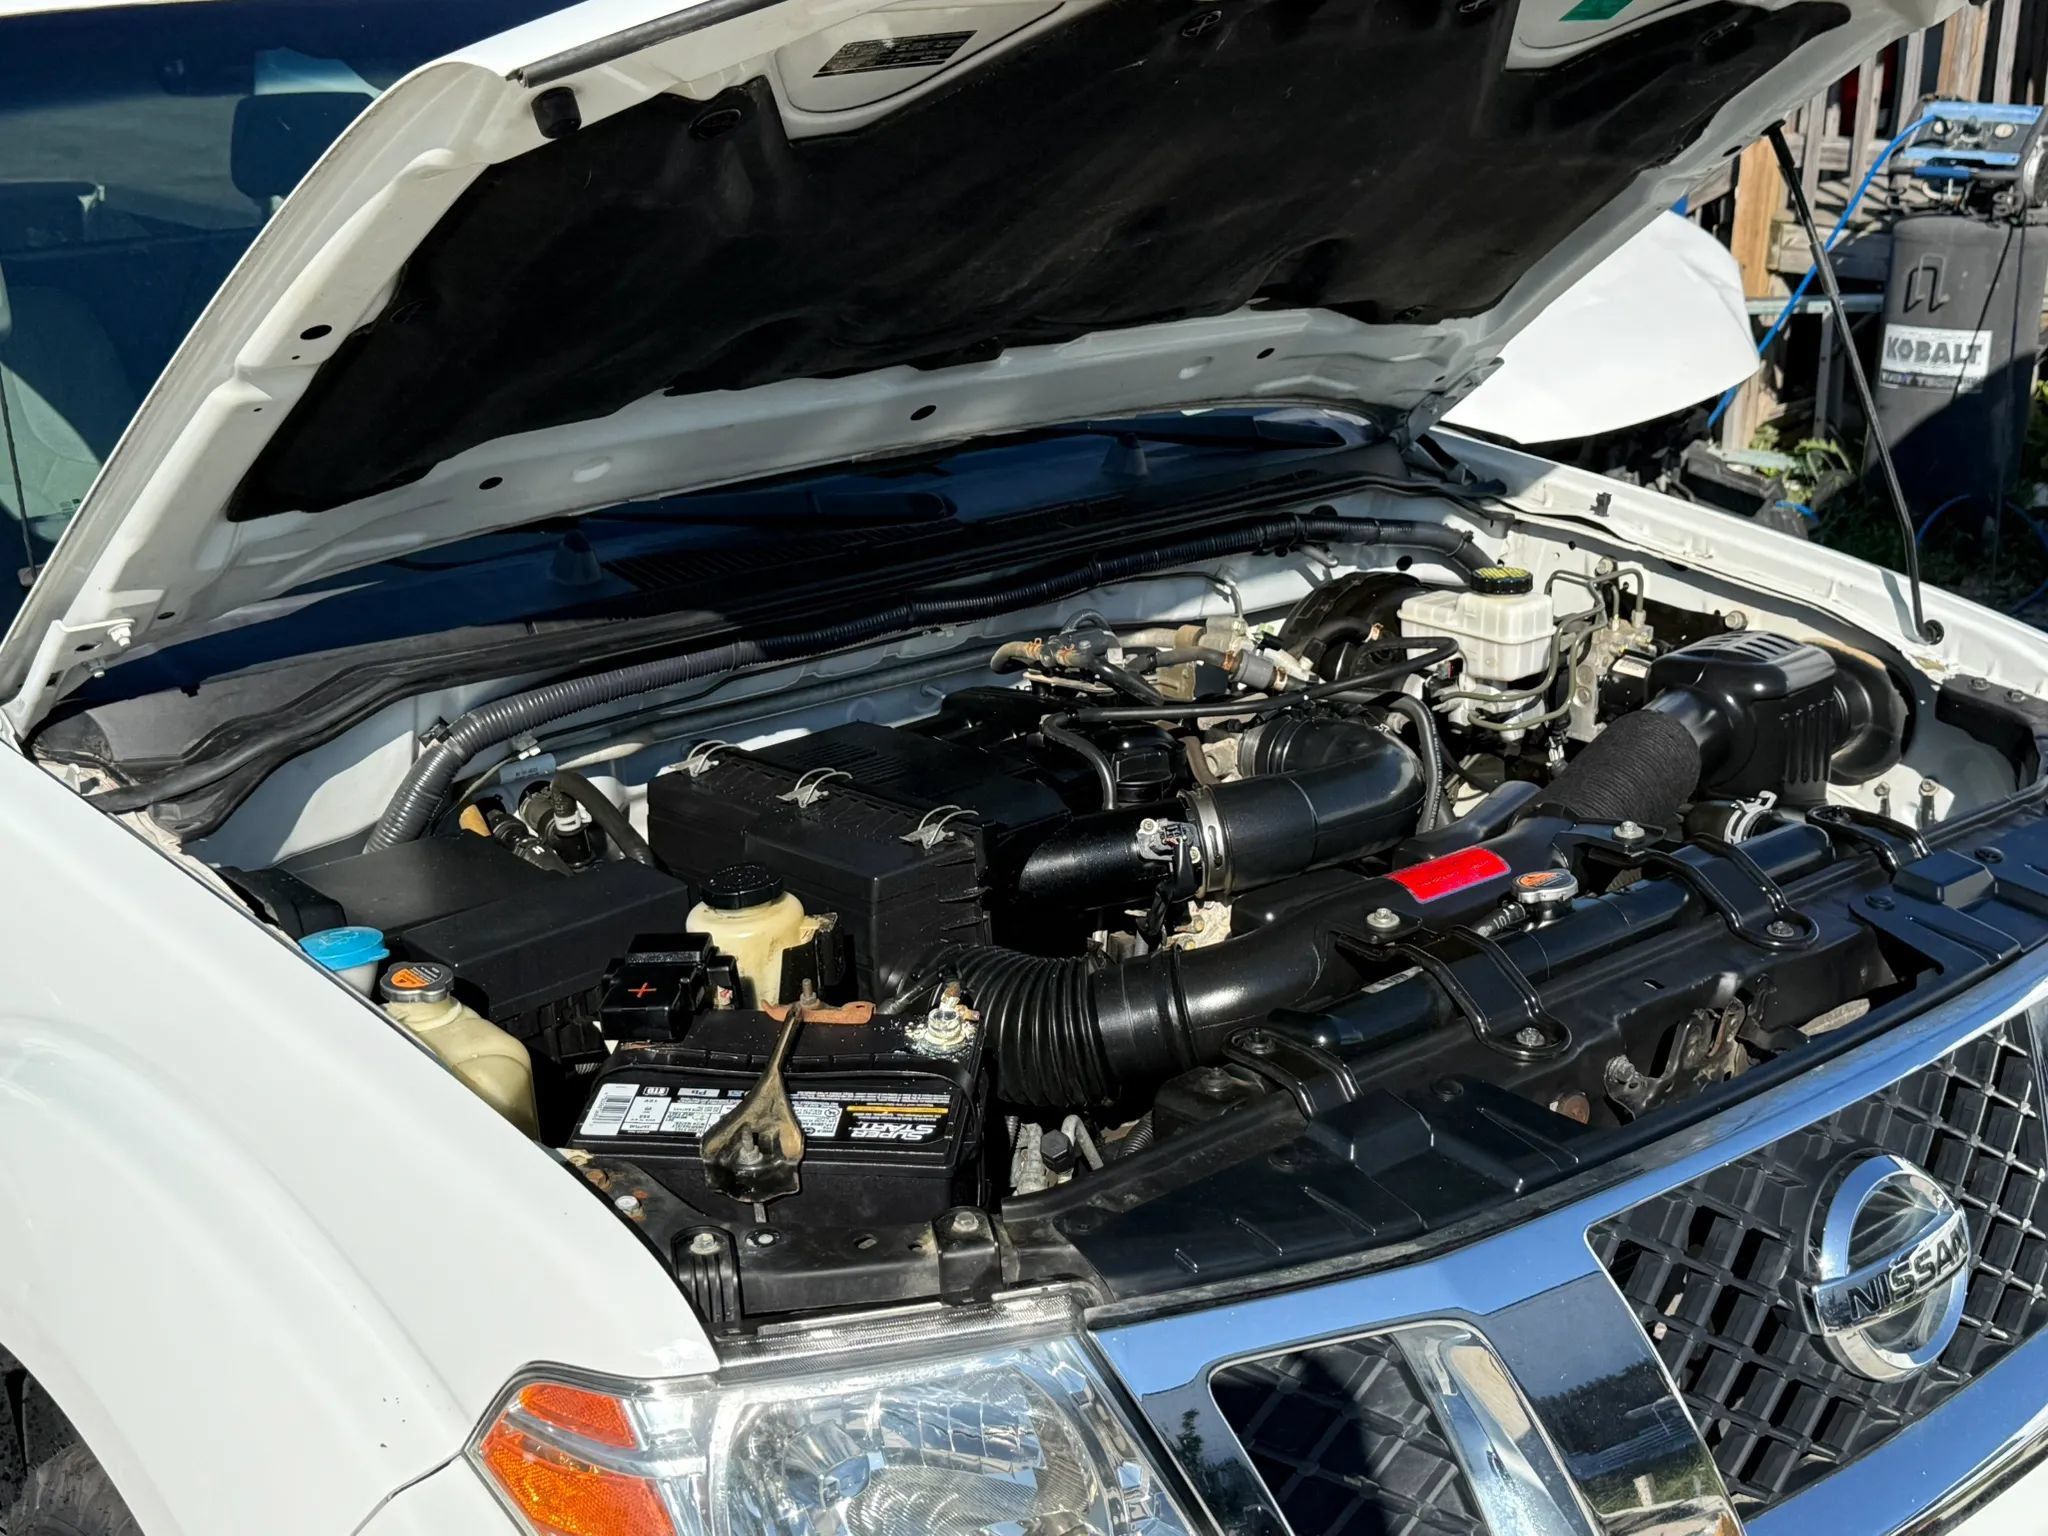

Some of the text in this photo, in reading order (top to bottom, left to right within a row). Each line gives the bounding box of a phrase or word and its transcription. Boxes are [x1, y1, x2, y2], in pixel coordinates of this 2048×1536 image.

[1886, 336, 1983, 364] KOBALT
[850, 1130, 923, 1142] SUPER
[852, 1122, 937, 1135] START
[1846, 1220, 1969, 1320] NISSAN
